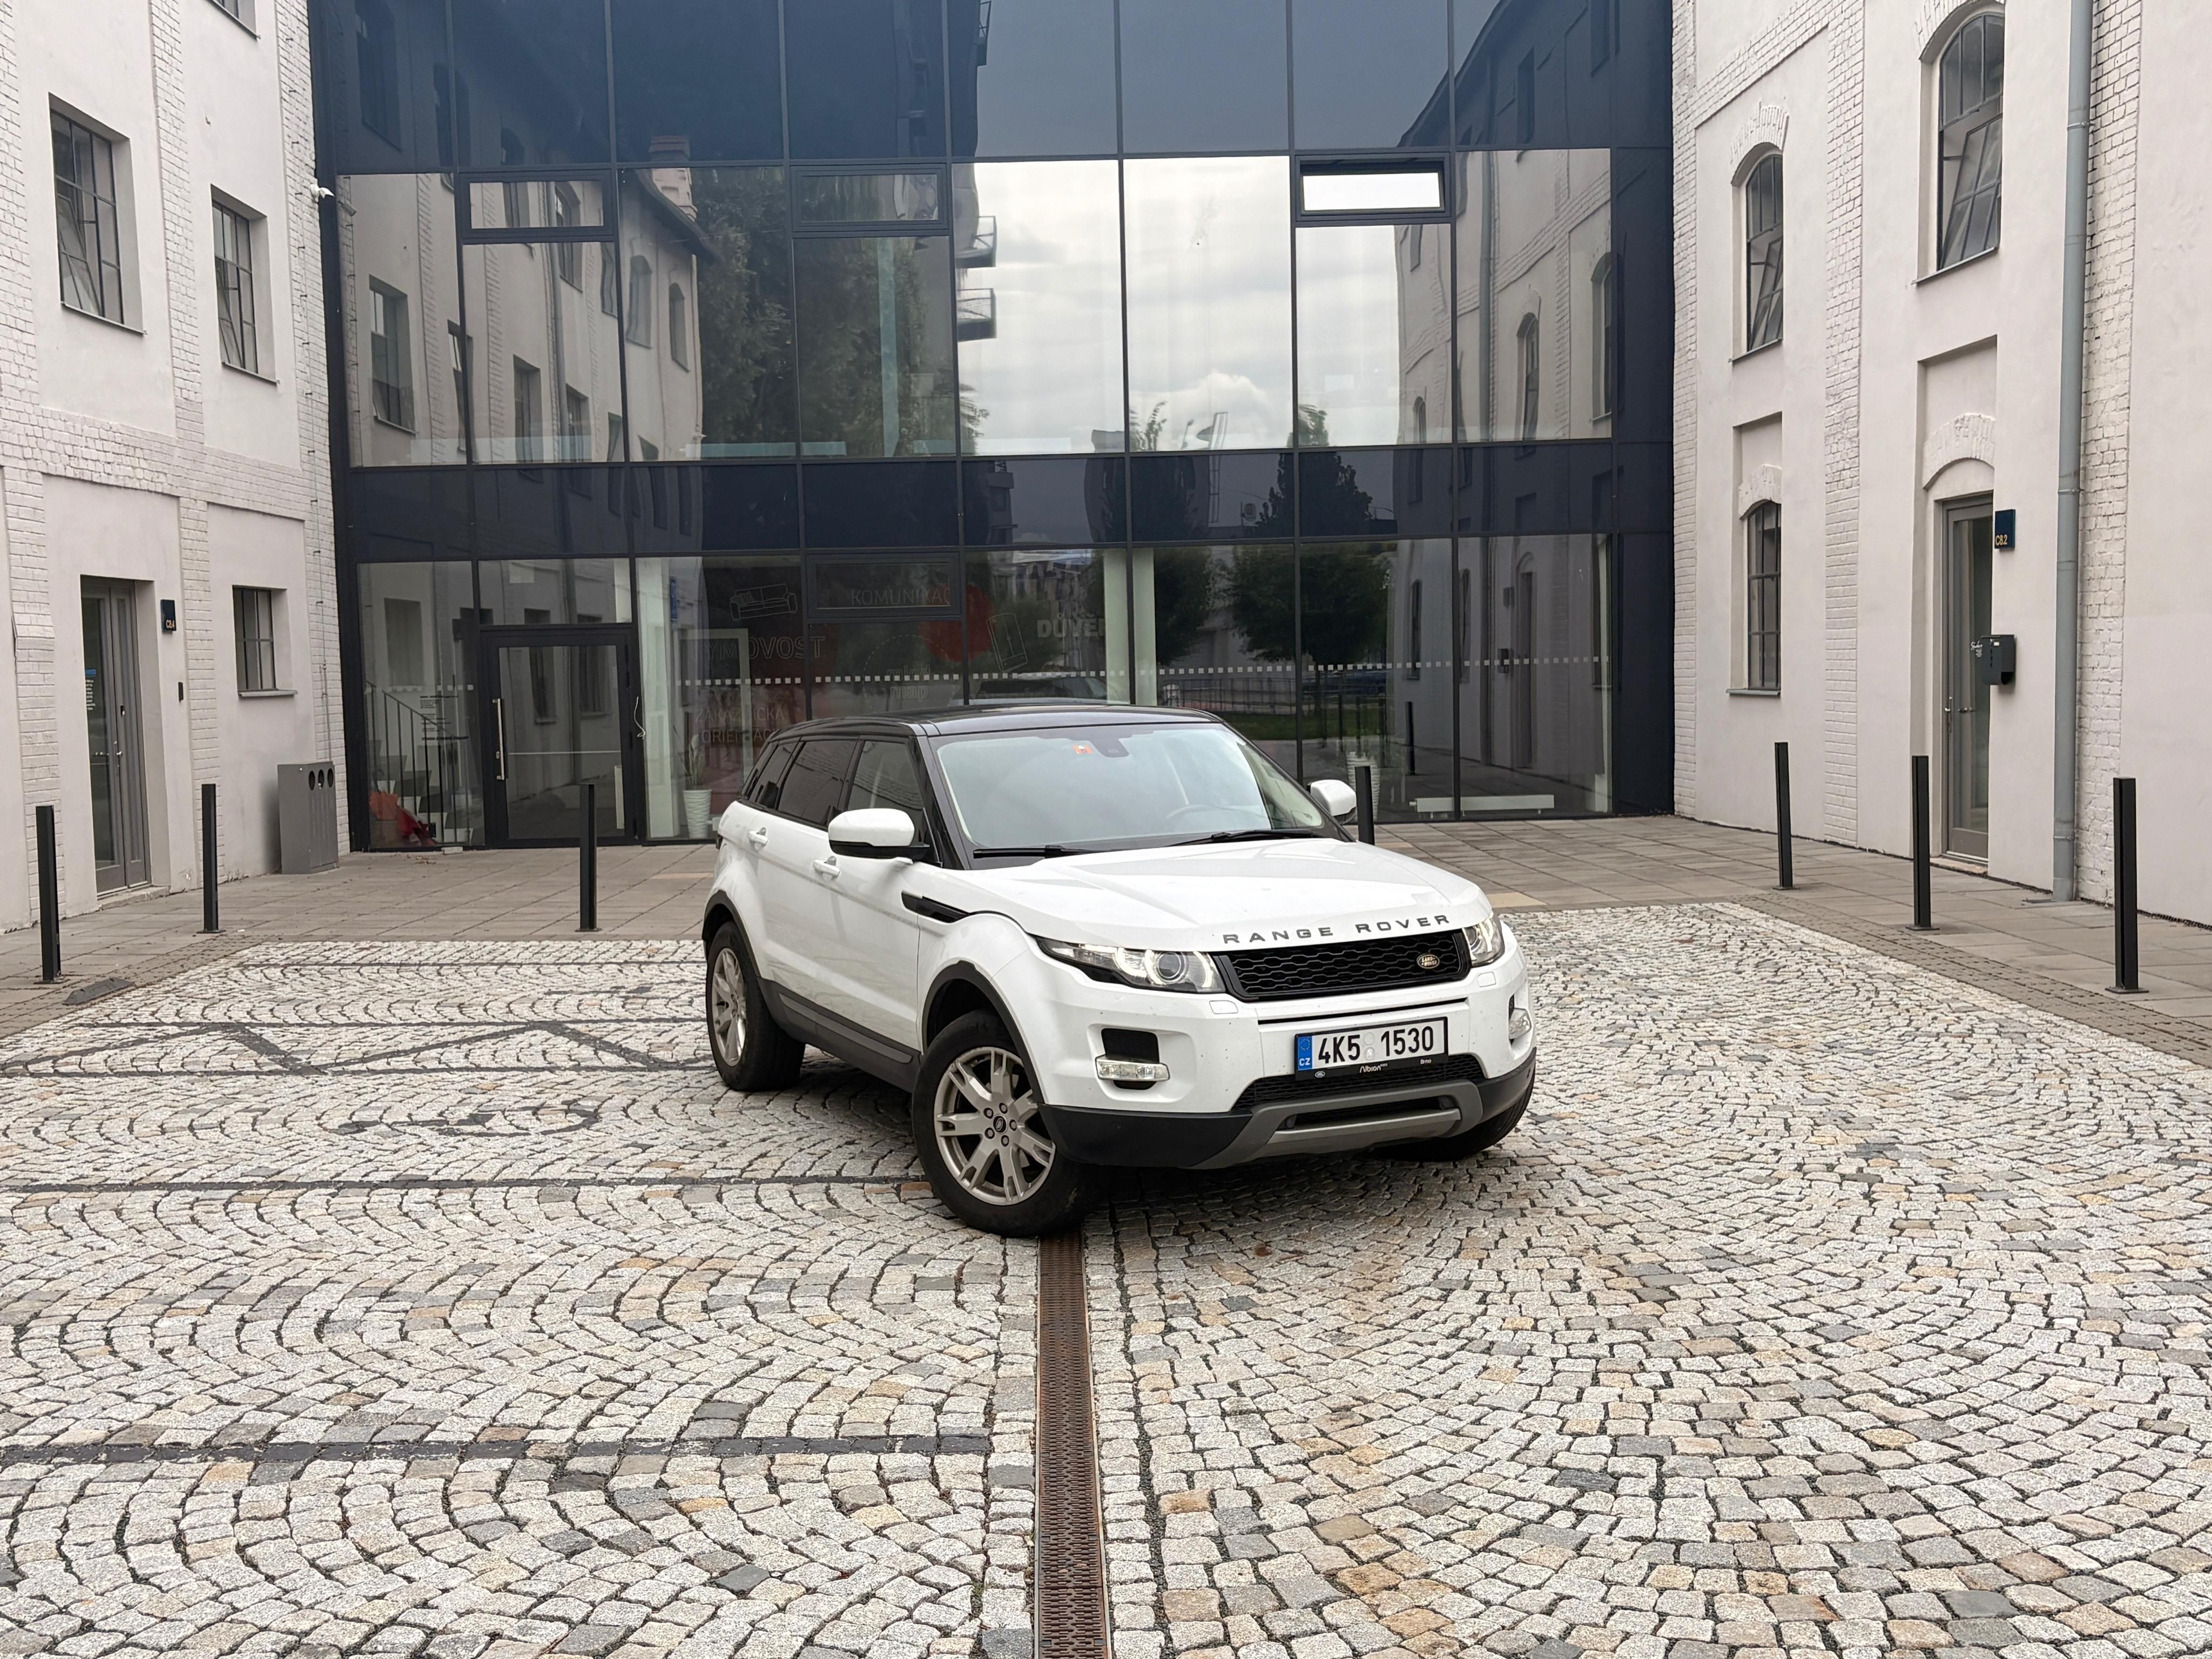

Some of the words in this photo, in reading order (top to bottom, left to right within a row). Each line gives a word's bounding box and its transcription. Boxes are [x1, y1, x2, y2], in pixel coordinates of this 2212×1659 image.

[890, 686, 928, 703] map
[1223, 927, 1333, 944] RANGE
[1355, 914, 1449, 933] ROVER
[1318, 1034, 1360, 1064] 4K5
[1381, 1026, 1434, 1057] 1530
[1299, 1058, 1311, 1067] CZ
